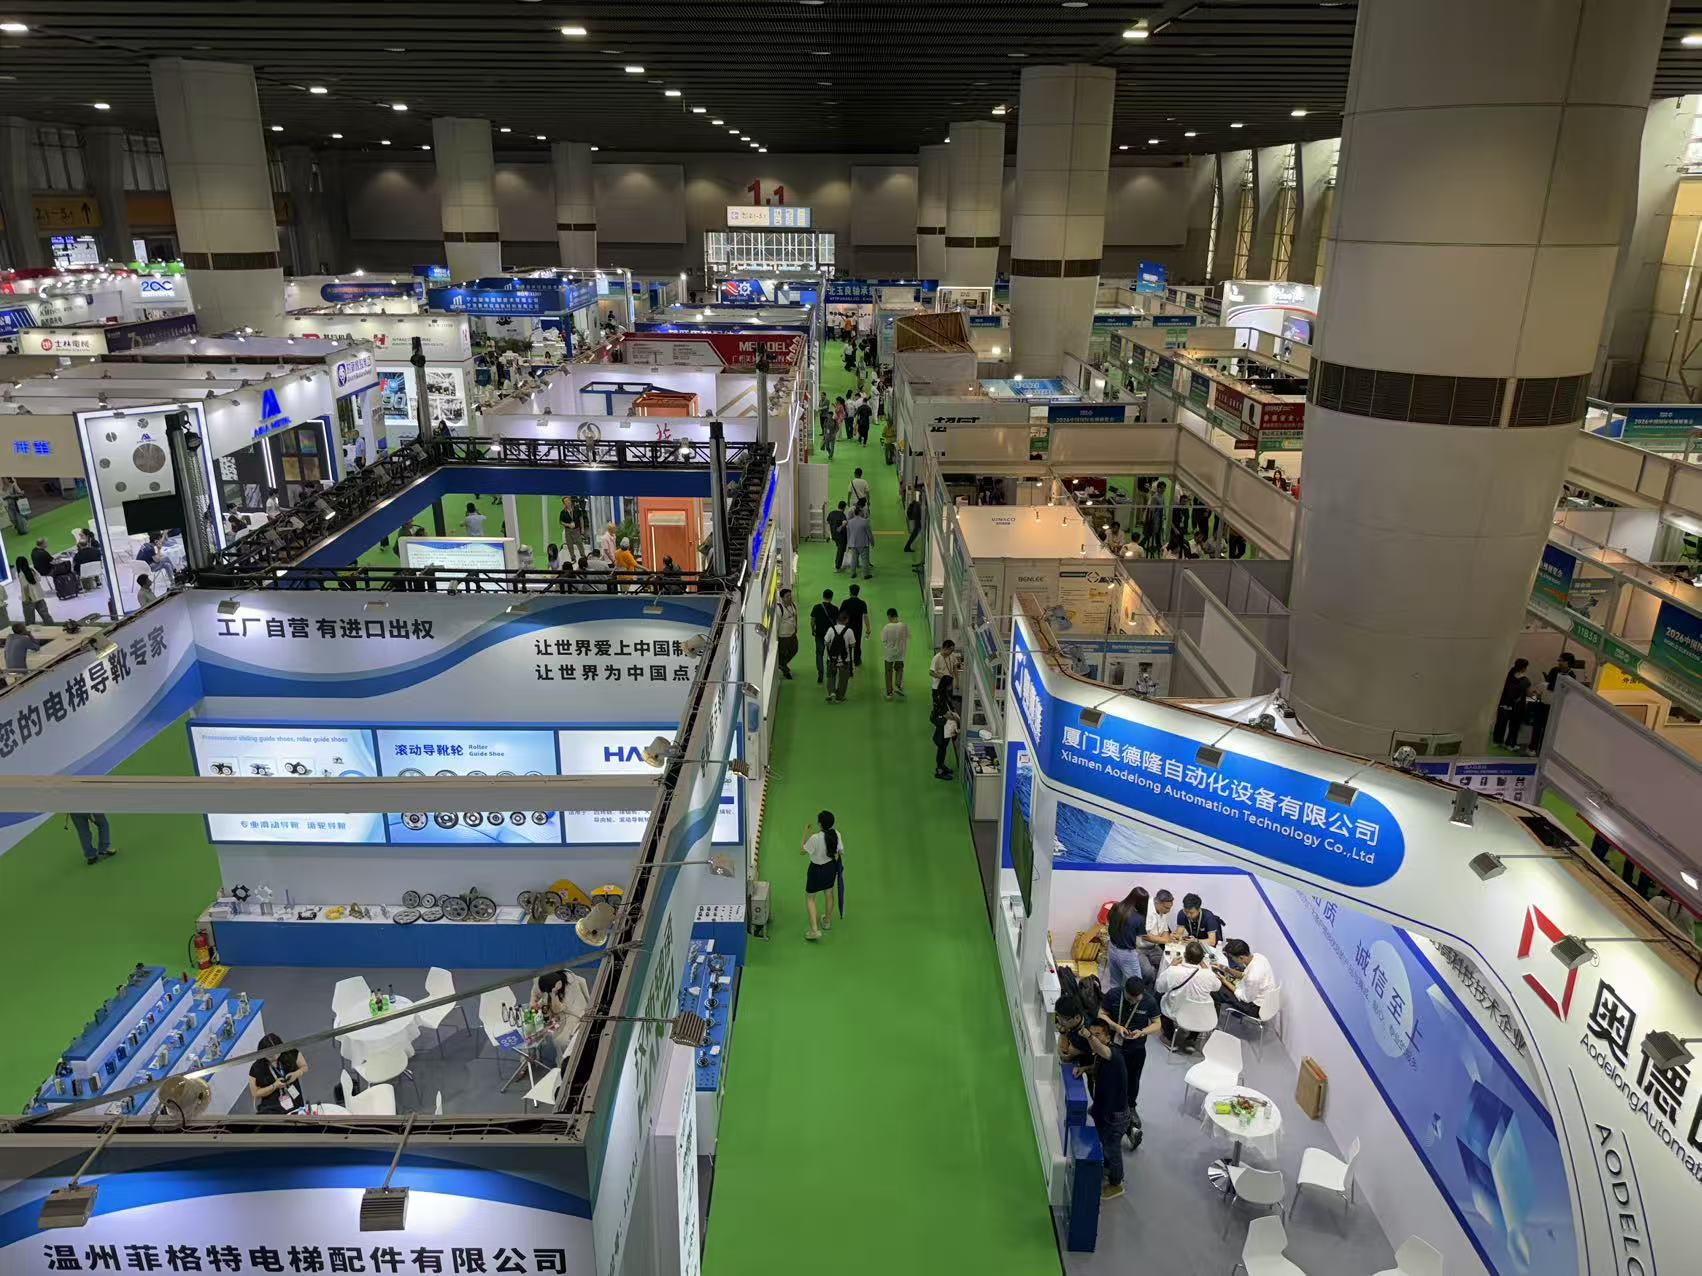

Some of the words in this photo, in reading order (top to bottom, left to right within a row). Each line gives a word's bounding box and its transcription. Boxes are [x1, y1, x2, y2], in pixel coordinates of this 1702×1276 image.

[747, 178, 785, 206] 1.1
[535, 664, 700, 682] 让世界为中国点
[394, 744, 464, 757] 滚动导靴轮
[1061, 750, 1103, 772] Xiamen
[1104, 763, 1162, 795] Aodelong
[1163, 783, 1240, 819] Automation
[1242, 810, 1322, 850] Technology
[1062, 726, 1381, 847] 厦门奥德隆自动化设备有限公司
[1586, 978, 1702, 1149] 奥德
[43, 1243, 567, 1274] 温州菲格特电梯配件有限公司
